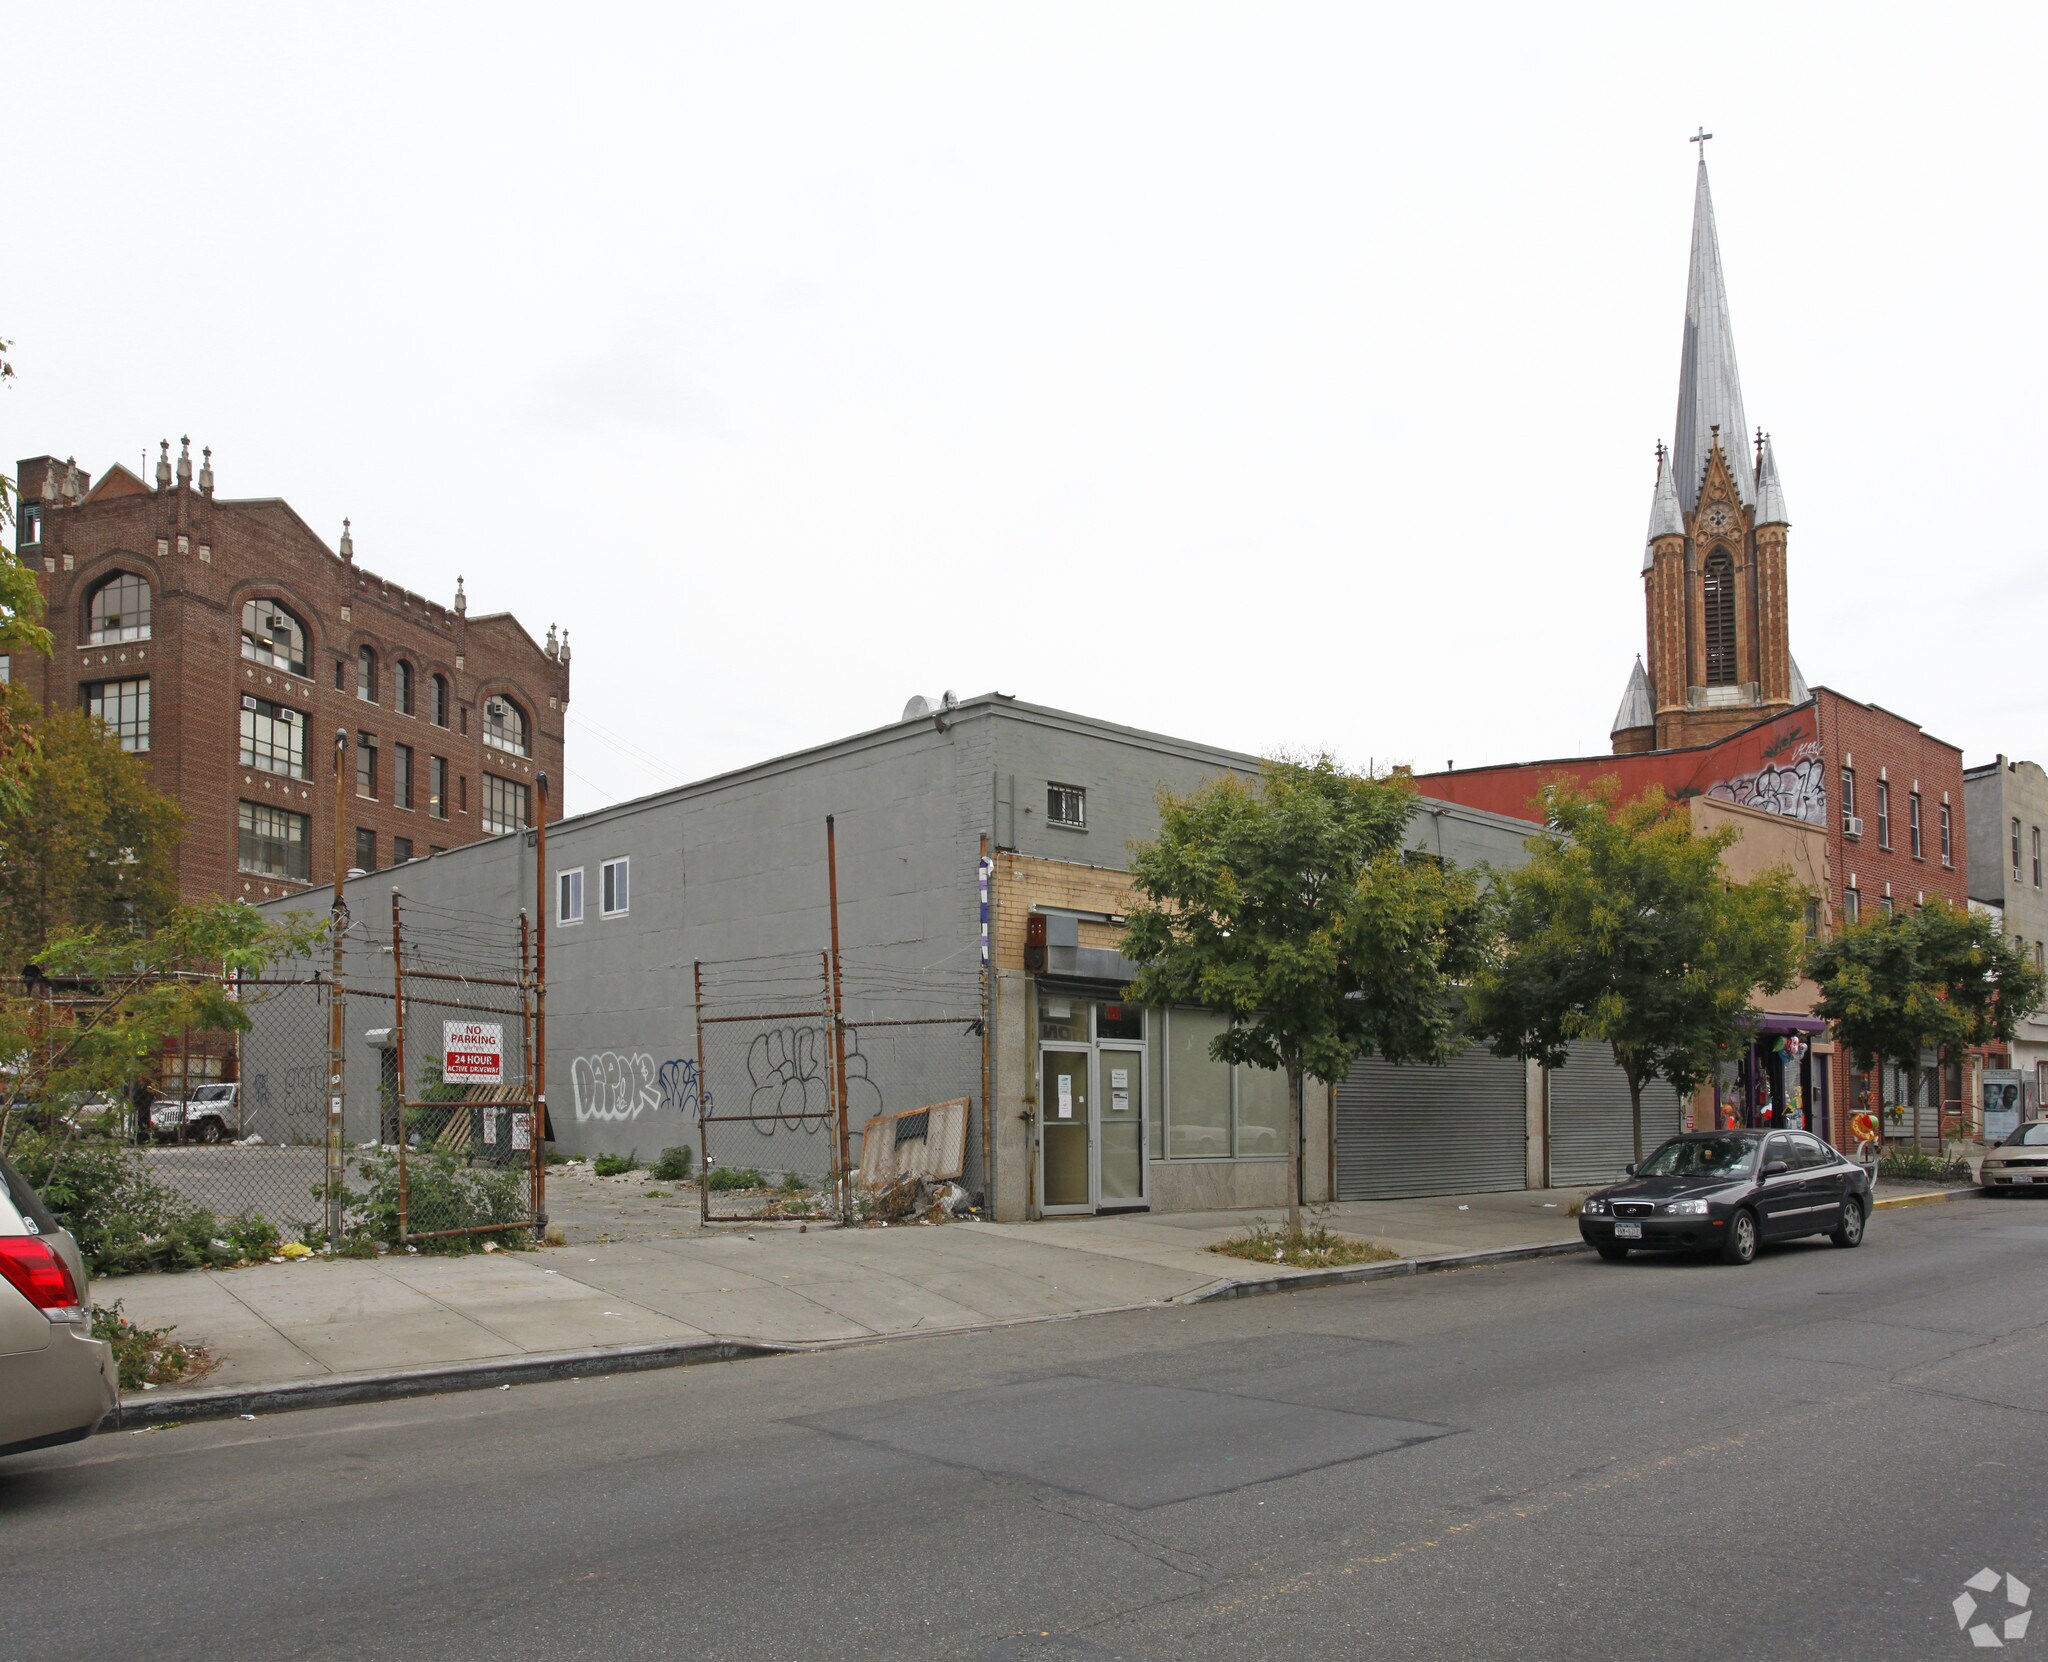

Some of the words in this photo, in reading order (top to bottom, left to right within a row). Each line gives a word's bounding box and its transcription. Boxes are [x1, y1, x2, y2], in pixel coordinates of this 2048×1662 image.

[466, 1025, 482, 1035] NO
[451, 1034, 496, 1045] PARKING
[455, 1055, 466, 1064] 24
[467, 1055, 493, 1065] HOUR
[469, 1066, 499, 1074] DRIVEWAY
